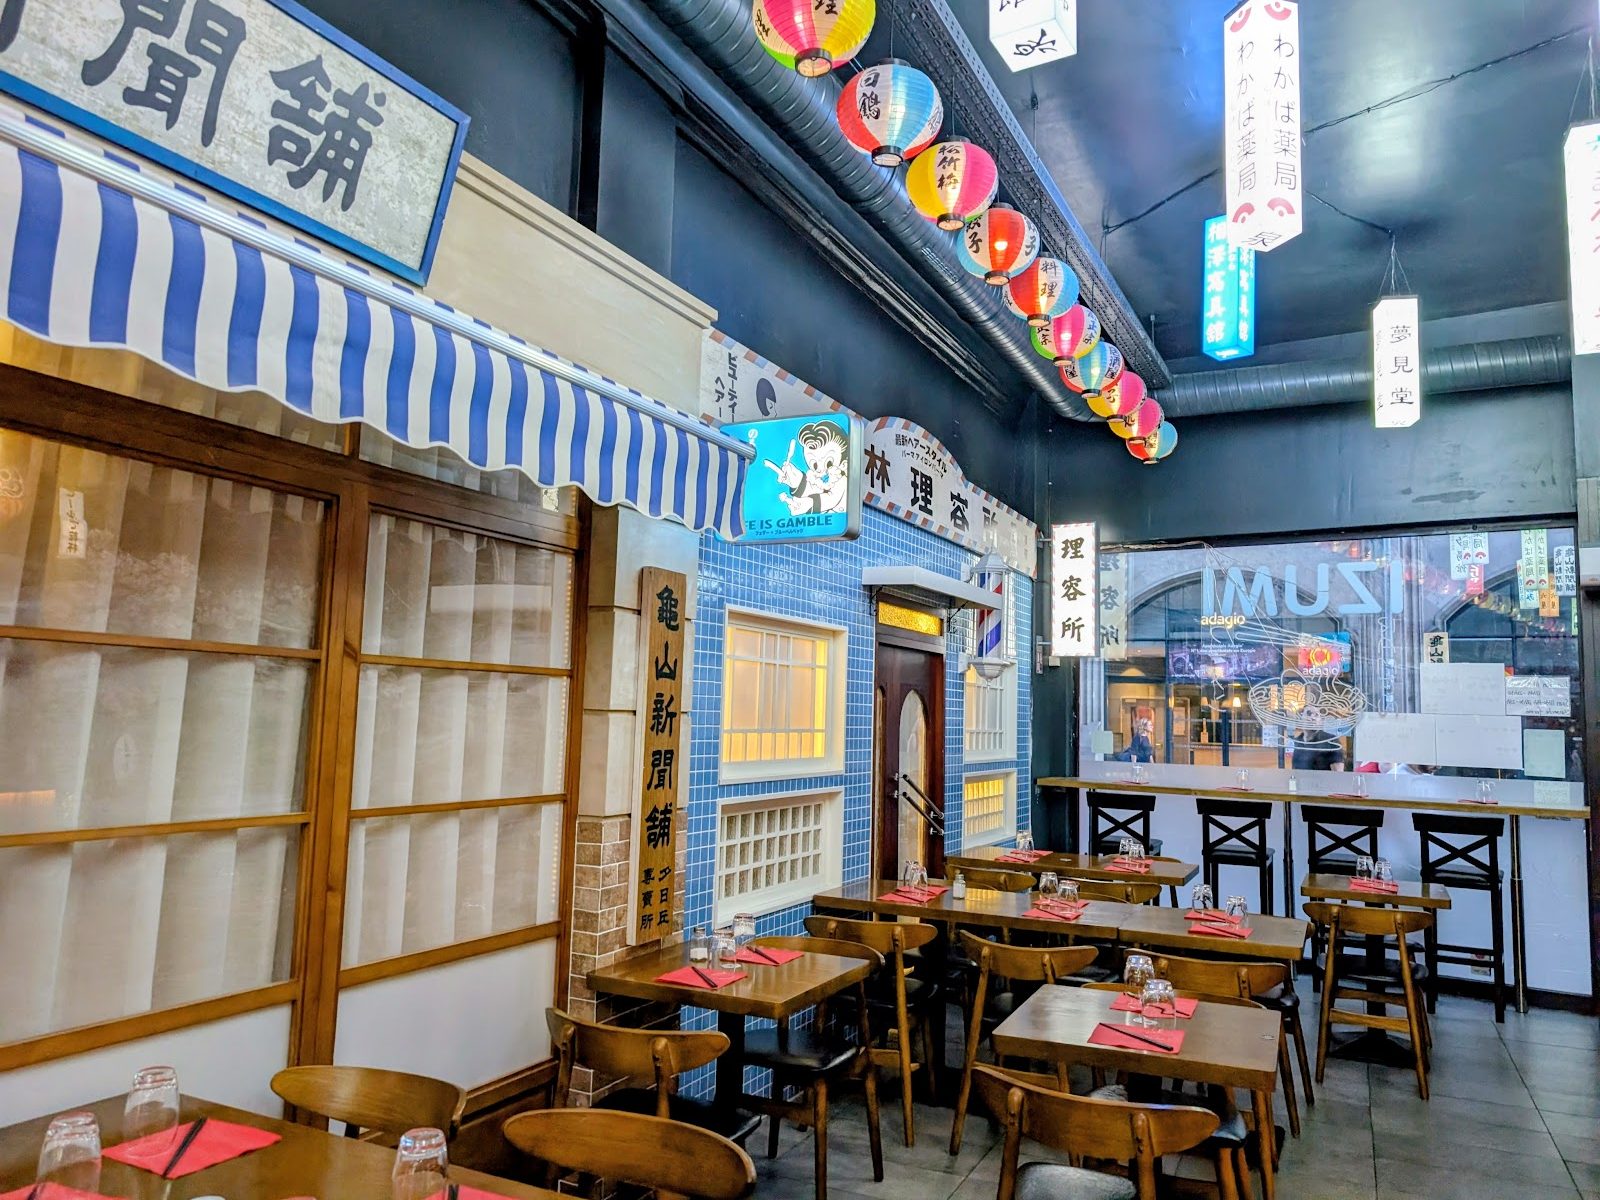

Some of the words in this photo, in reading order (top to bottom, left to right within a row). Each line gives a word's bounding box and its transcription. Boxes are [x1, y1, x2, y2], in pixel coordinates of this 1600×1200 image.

[1236, 39, 1258, 197] わかば薬局
[1272, 32, 1298, 192] わかば薬局
[1039, 260, 1059, 299] 料理
[1389, 324, 1415, 406] 夢見堂
[760, 519, 772, 530] IS
[776, 515, 833, 529] GAMBLE
[1060, 536, 1087, 643] 理容所
[1201, 612, 1246, 629] adagio
[1302, 664, 1340, 678] adagio
[657, 865, 672, 926] 夕日丘
